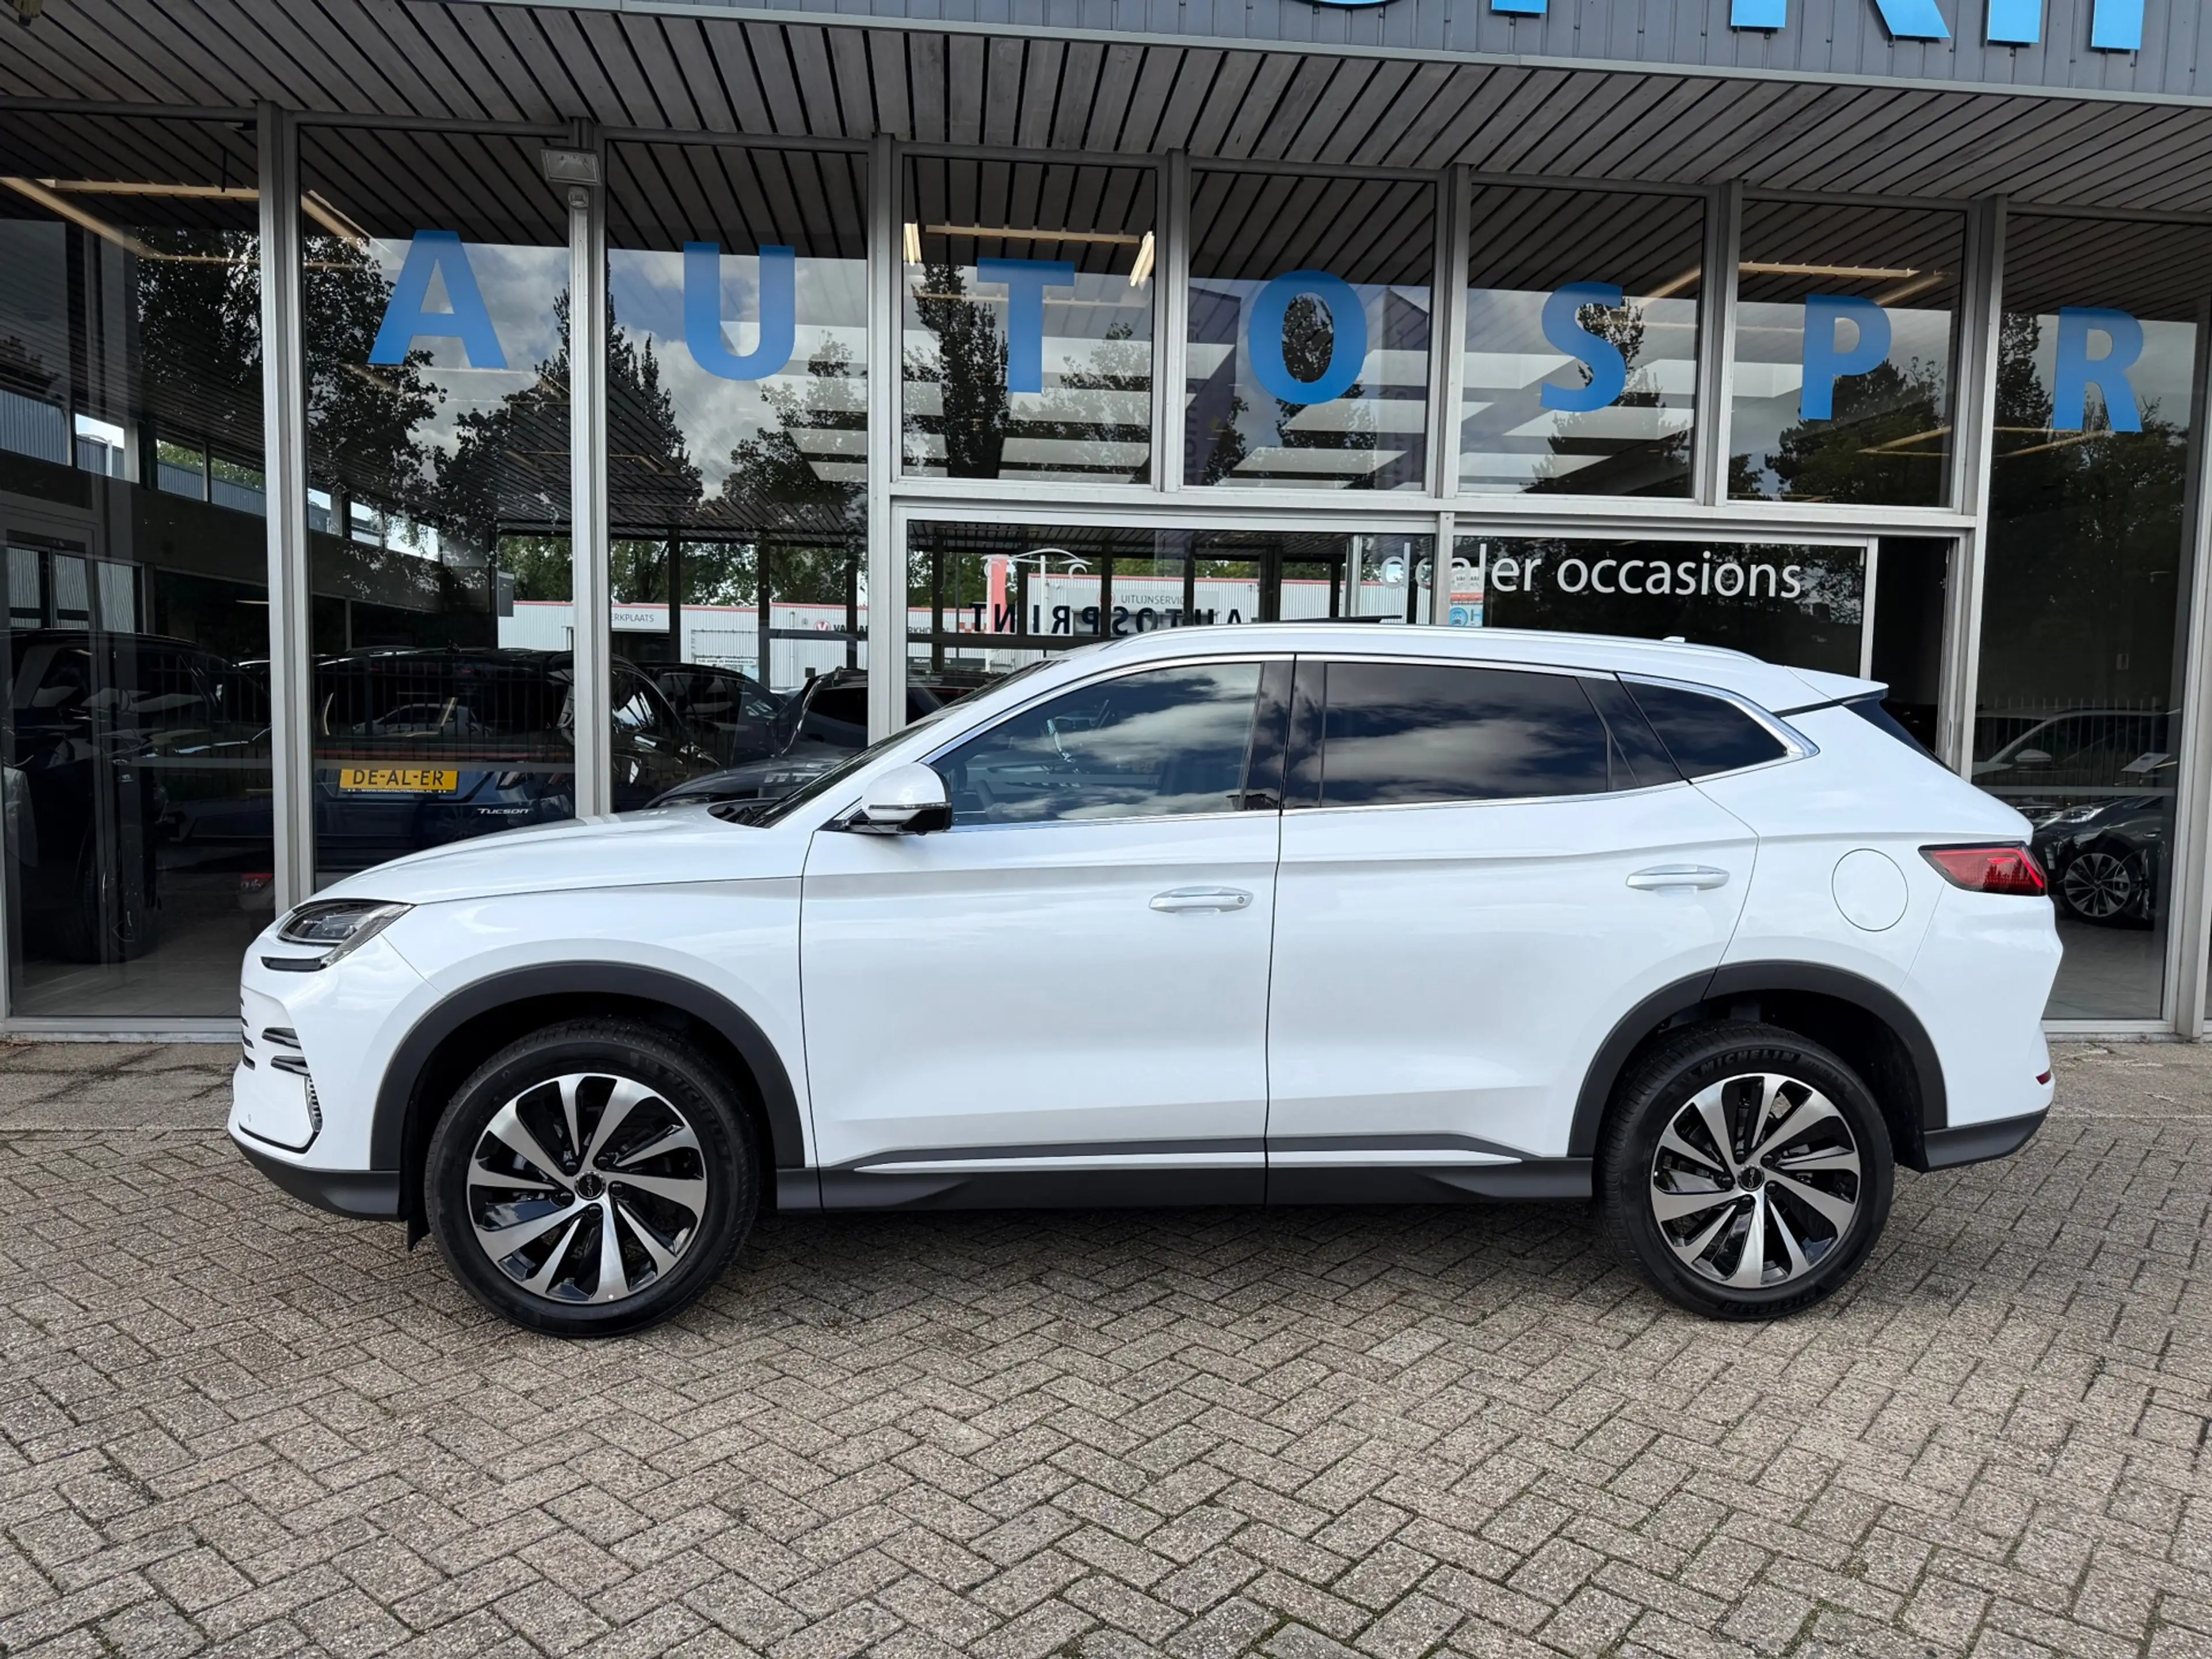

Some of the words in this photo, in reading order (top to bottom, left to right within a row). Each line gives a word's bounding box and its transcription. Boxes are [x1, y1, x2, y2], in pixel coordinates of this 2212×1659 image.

[1382, 543, 1540, 592] dealer
[1556, 551, 1801, 598] occasions
[1121, 594, 1184, 605] UITLIJNSERVIC
[612, 613, 654, 622] RKPLAATS
[353, 769, 445, 786] DE-AL-ER
[1699, 1048, 1796, 1074] MICHELIN
